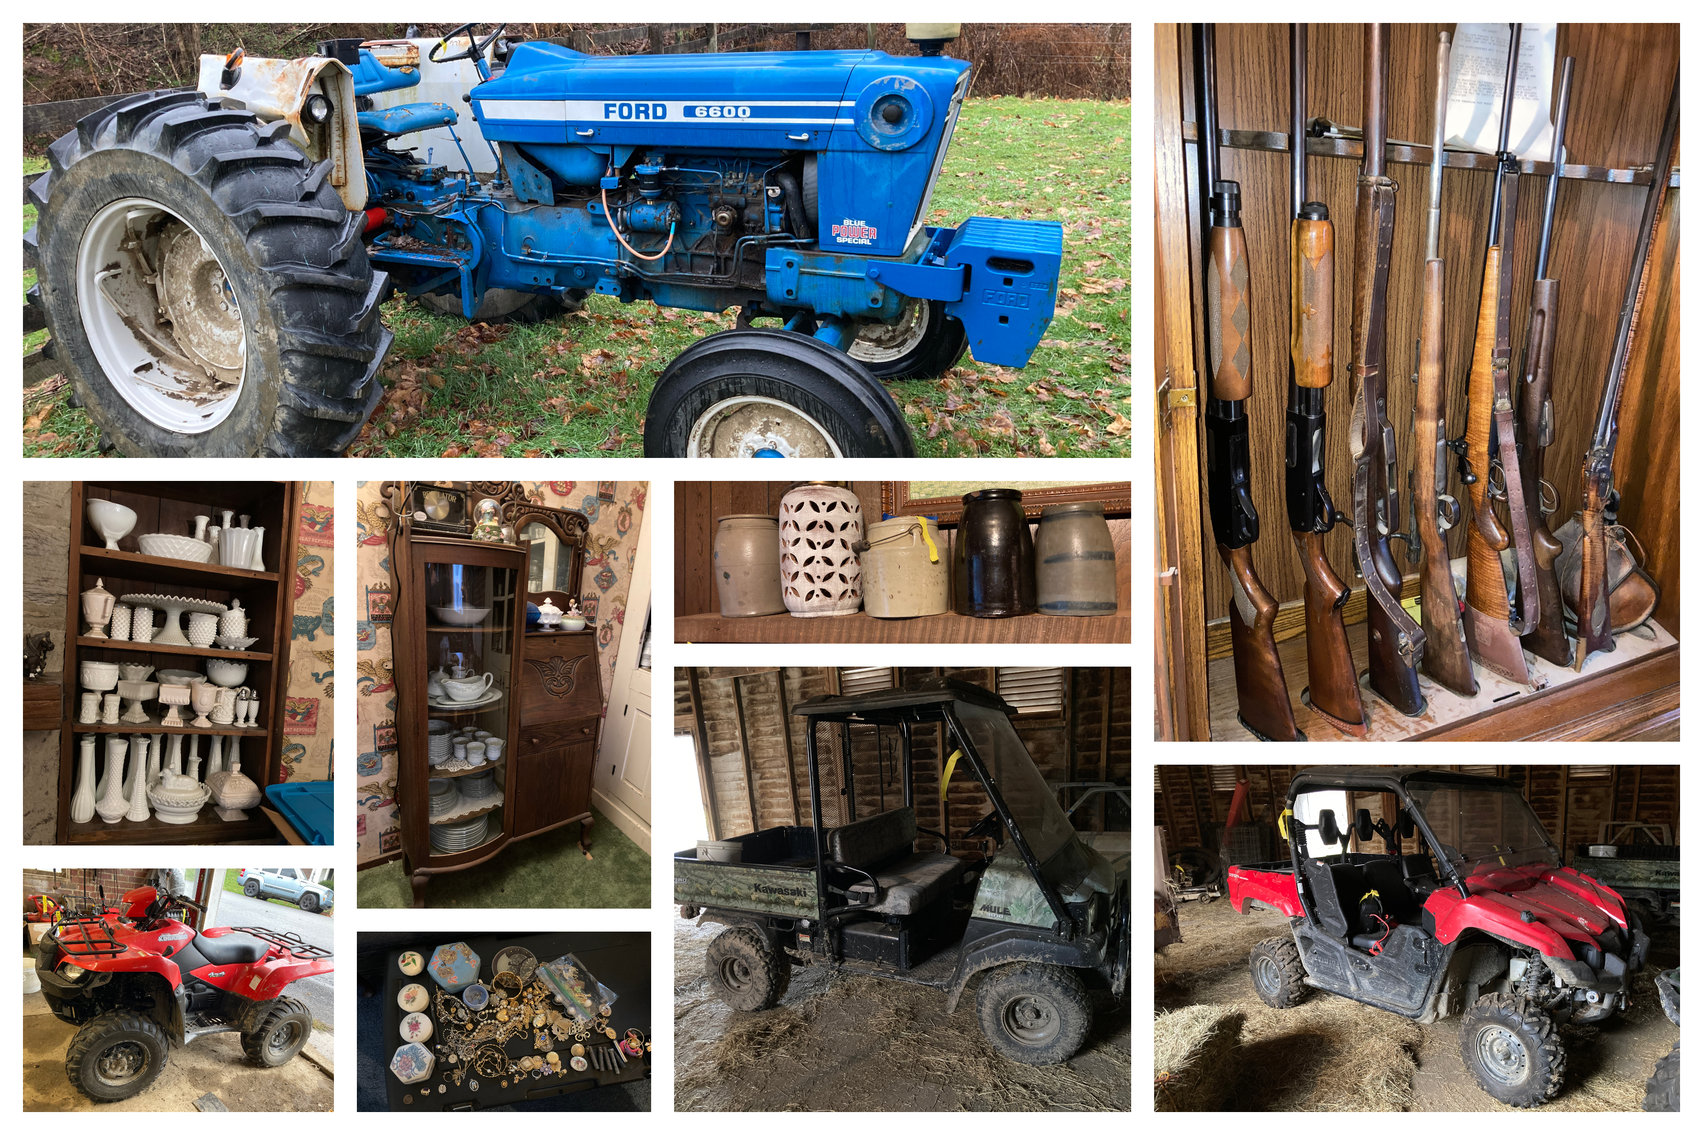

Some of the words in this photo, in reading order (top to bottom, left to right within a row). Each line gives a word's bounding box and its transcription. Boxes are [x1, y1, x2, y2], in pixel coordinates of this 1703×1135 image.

[604, 102, 667, 119] FORD
[695, 106, 751, 118] 6600
[832, 224, 878, 239] POWER
[836, 236, 872, 245] SPECIAL
[983, 289, 1030, 309] FORD
[753, 883, 807, 898] Kawasaki
[980, 904, 1011, 916] MULE
